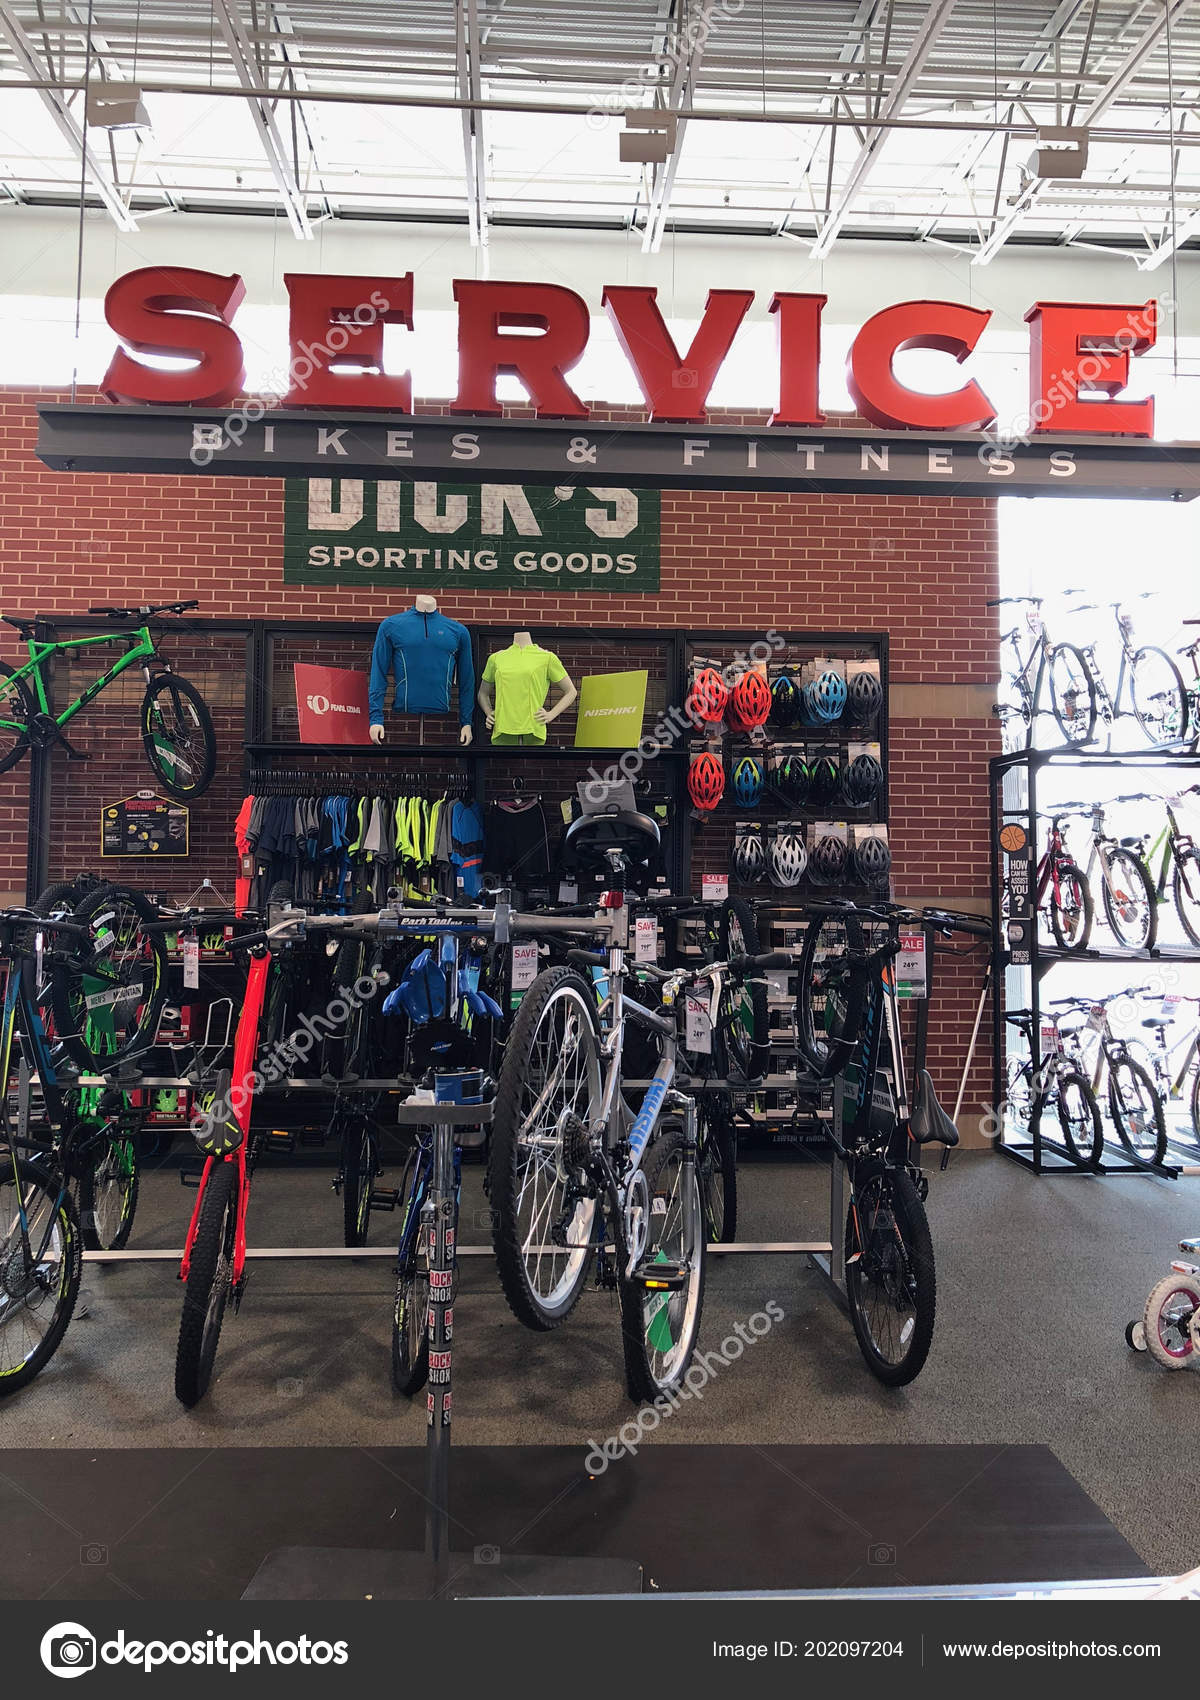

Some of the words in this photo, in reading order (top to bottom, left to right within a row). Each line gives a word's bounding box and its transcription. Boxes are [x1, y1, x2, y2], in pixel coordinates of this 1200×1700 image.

[98, 265, 1157, 439] SERVICE
[193, 423, 481, 460] BIKES
[566, 437, 597, 464] &
[683, 439, 1077, 477] FITNESS
[308, 545, 499, 571] SPORTING
[513, 551, 638, 574] GOODS
[584, 705, 637, 718] NISHIKI
[1010, 860, 1029, 870] HOW
[1010, 877, 1029, 885] ASSIST
[1010, 884, 1029, 895] YOU
[1014, 895, 1025, 912] ?
[400, 917, 427, 926] Park
[427, 917, 452, 926] Tool
[637, 921, 656, 931] SAVE
[514, 948, 537, 959] SAVE
[1012, 950, 1029, 958] PRESS
[430, 1271, 452, 1287] ROCK
[429, 1287, 451, 1302] SHOX
[428, 1352, 451, 1368] ROCK
[428, 1368, 451, 1384] SHOX
